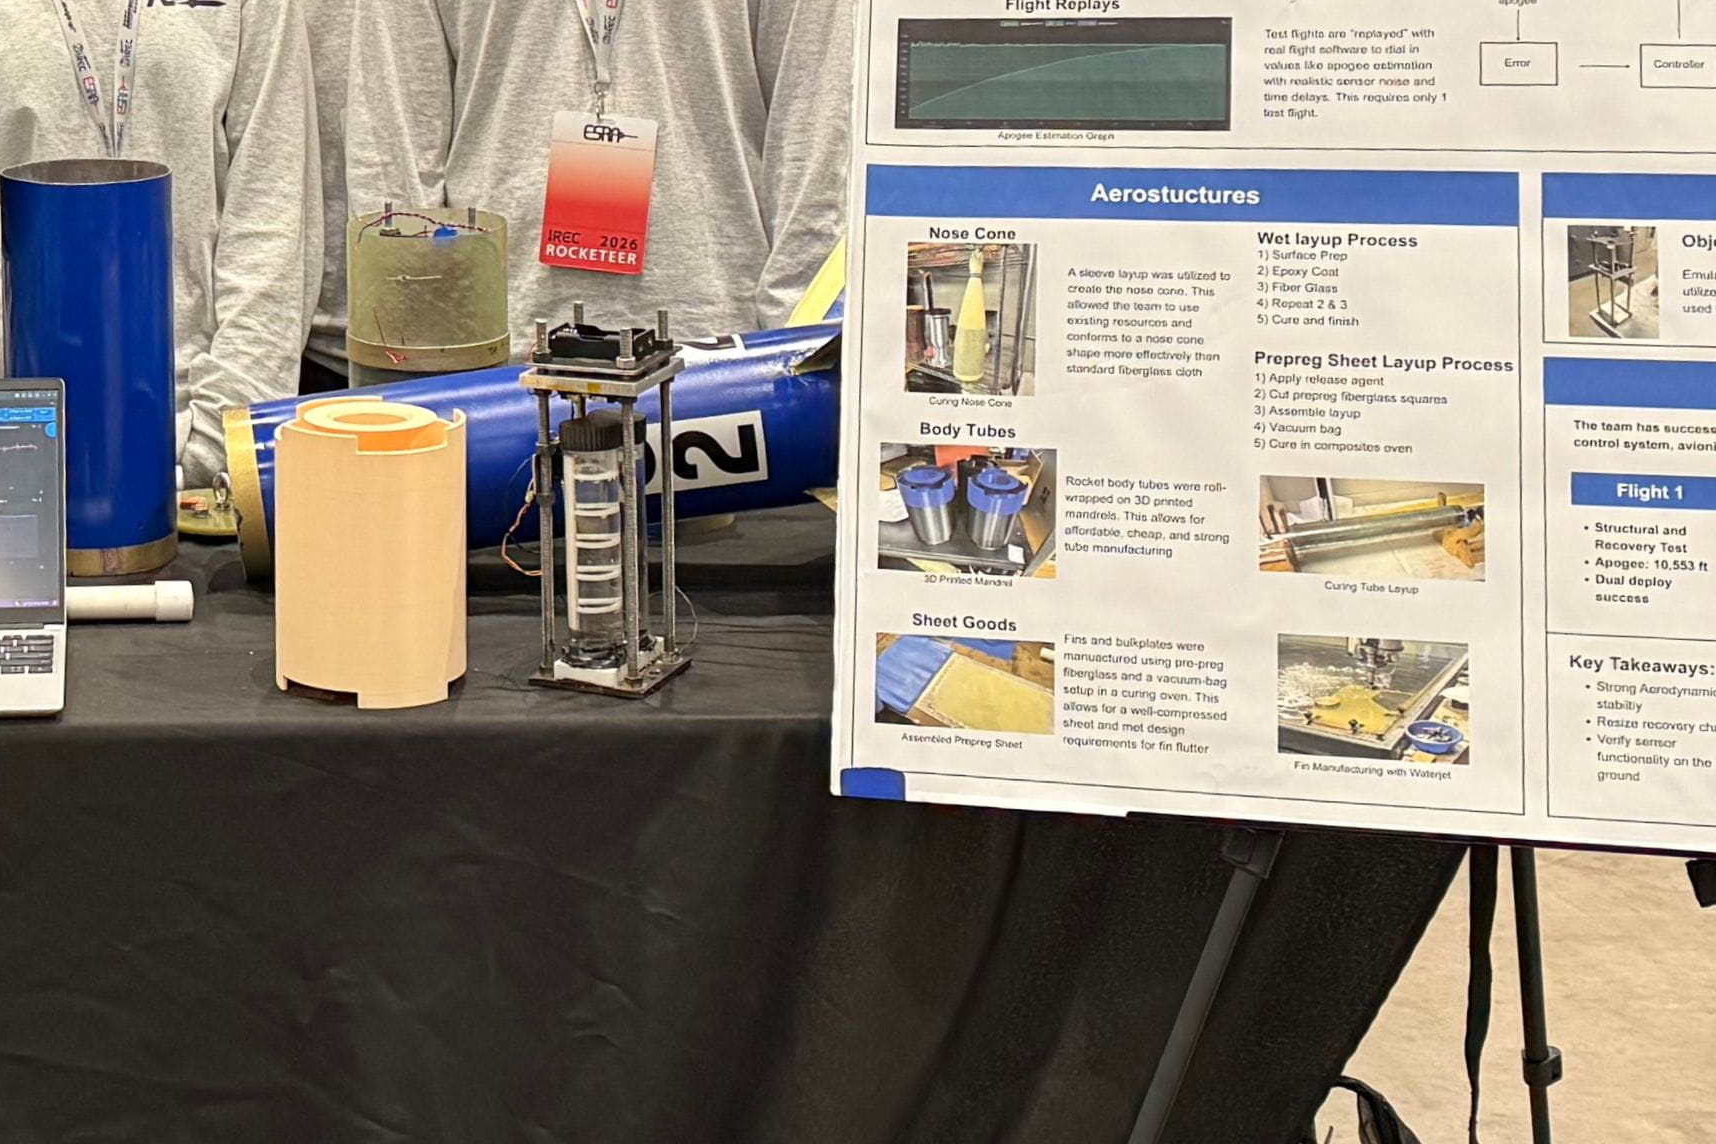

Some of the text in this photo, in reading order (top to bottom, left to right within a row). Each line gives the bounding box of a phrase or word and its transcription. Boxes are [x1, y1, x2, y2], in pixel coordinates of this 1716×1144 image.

[1504, 57, 1531, 67] Error
[1653, 59, 1704, 69] Controller
[1090, 184, 1260, 204] Aerostuctures
[548, 229, 638, 250] IREC 2026
[929, 226, 1016, 240] Nose Cone
[1257, 231, 1418, 248] Wet layup Process
[545, 244, 637, 265] ROCKETEER
[1254, 350, 1513, 372] Prepreg Sheet Layup Process
[920, 421, 1016, 439] Body Tubes
[1616, 483, 1682, 502] Flight 1
[1595, 522, 1686, 536] Structural and
[1594, 539, 1687, 554] Recovery Test
[1594, 556, 1648, 570] Apogee:
[1654, 559, 1695, 571] 10,553
[1595, 574, 1672, 589] Dual deploy
[1595, 593, 1649, 603] success
[912, 612, 1016, 631] Sheet Goods
[1569, 655, 1714, 677] Key Takeaways:
